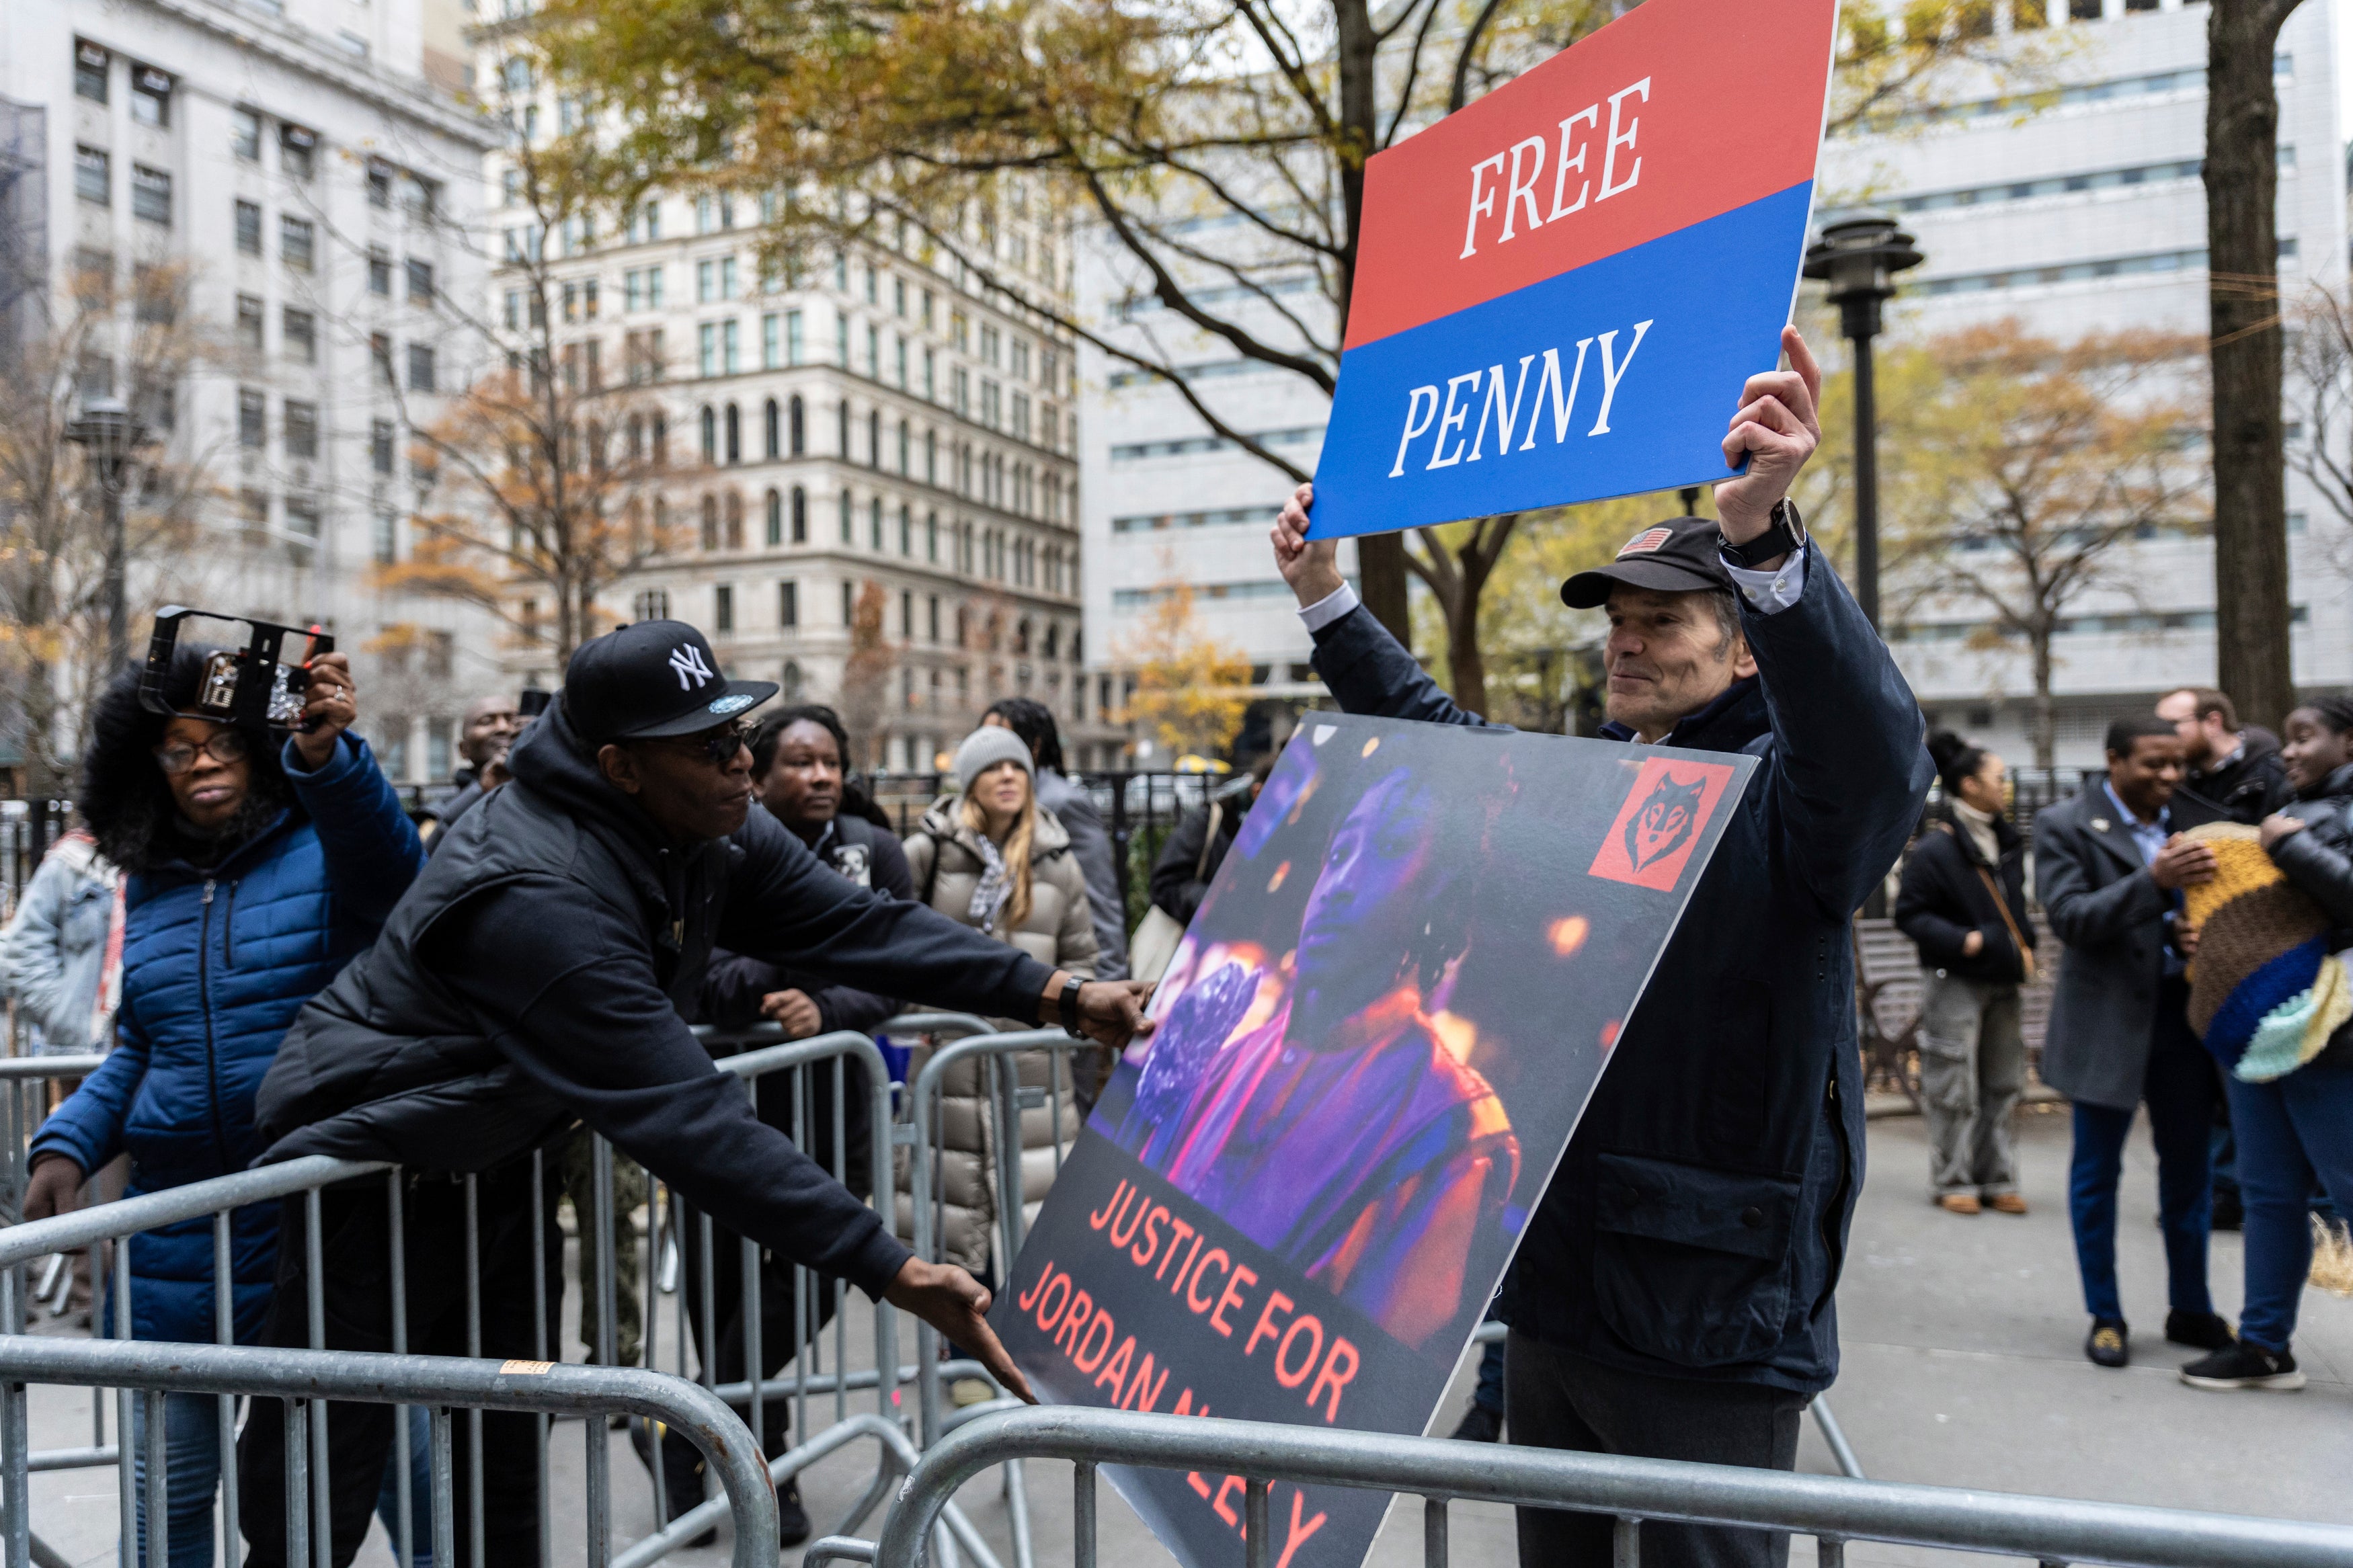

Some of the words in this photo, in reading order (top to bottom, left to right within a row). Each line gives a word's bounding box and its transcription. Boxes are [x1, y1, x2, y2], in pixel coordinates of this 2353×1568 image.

[1459, 76, 1651, 260] FREE
[1388, 319, 1654, 478] PENNY
[668, 643, 714, 692] NY
[1019, 1261, 1169, 1412] JORDAN
[1090, 1179, 1259, 1337] JUSTICE
[1245, 1290, 1360, 1423] FOR
